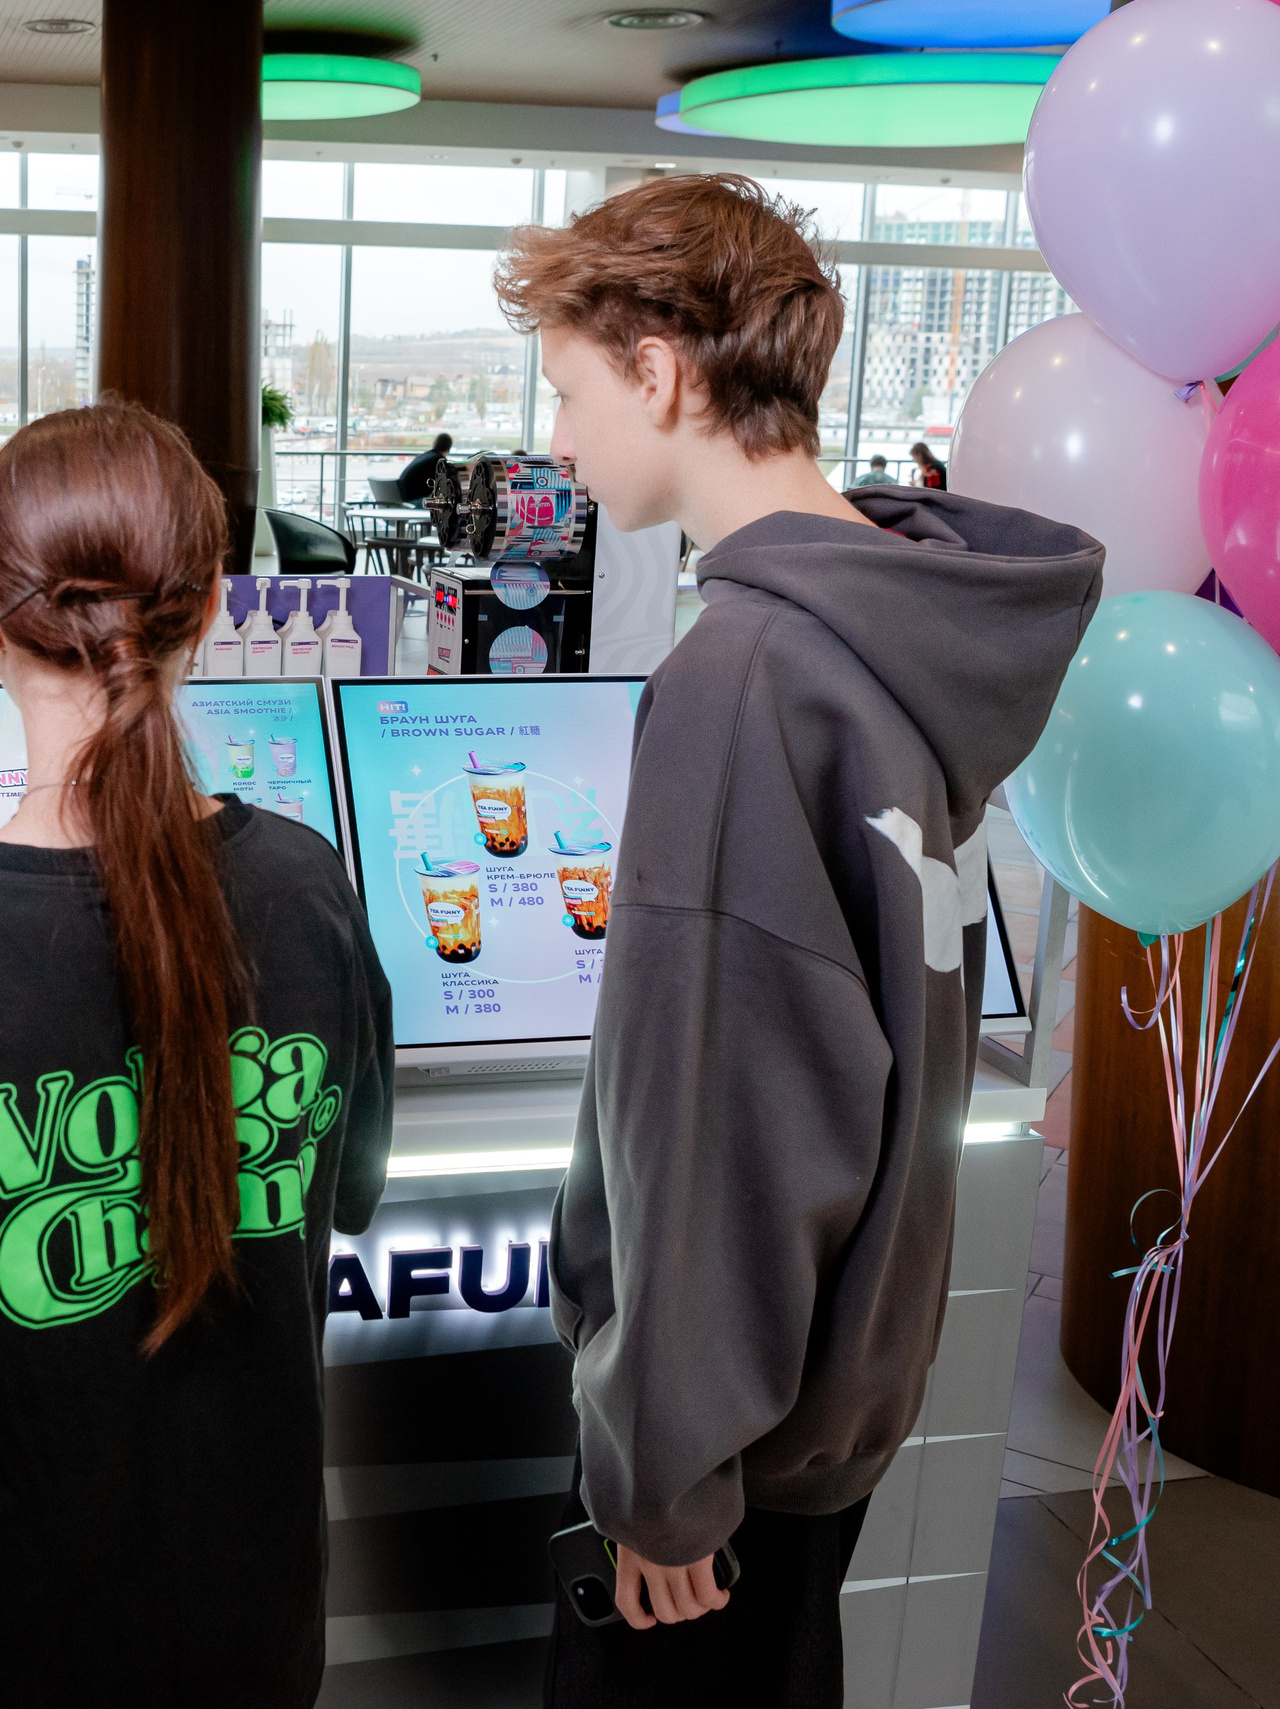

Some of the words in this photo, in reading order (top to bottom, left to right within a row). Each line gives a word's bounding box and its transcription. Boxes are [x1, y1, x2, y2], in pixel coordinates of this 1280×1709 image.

[191, 699, 254, 708] АЗИАТСКИЙ
[380, 703, 407, 712] HIT!
[233, 707, 287, 715] SMOOTHIE
[379, 715, 430, 725] БРАУН
[434, 714, 478, 724] ШУГА
[390, 727, 450, 738] BROWN
[454, 727, 506, 737] SUGAR
[486, 872, 556, 881] КРЕМ-БРЮЛЕ
[488, 883, 498, 893] S
[512, 882, 539, 892] 380
[490, 897, 504, 907] M
[518, 896, 545, 906] 480
[574, 948, 603, 956] ШУГА
[576, 959, 586, 969] S
[442, 979, 500, 987] КЛАССИКА
[579, 973, 592, 983] M
[443, 990, 454, 1000] S
[468, 988, 496, 999] 300
[445, 1004, 460, 1015] M
[474, 1003, 502, 1014] 380
[328, 1241, 550, 1321] AFU
